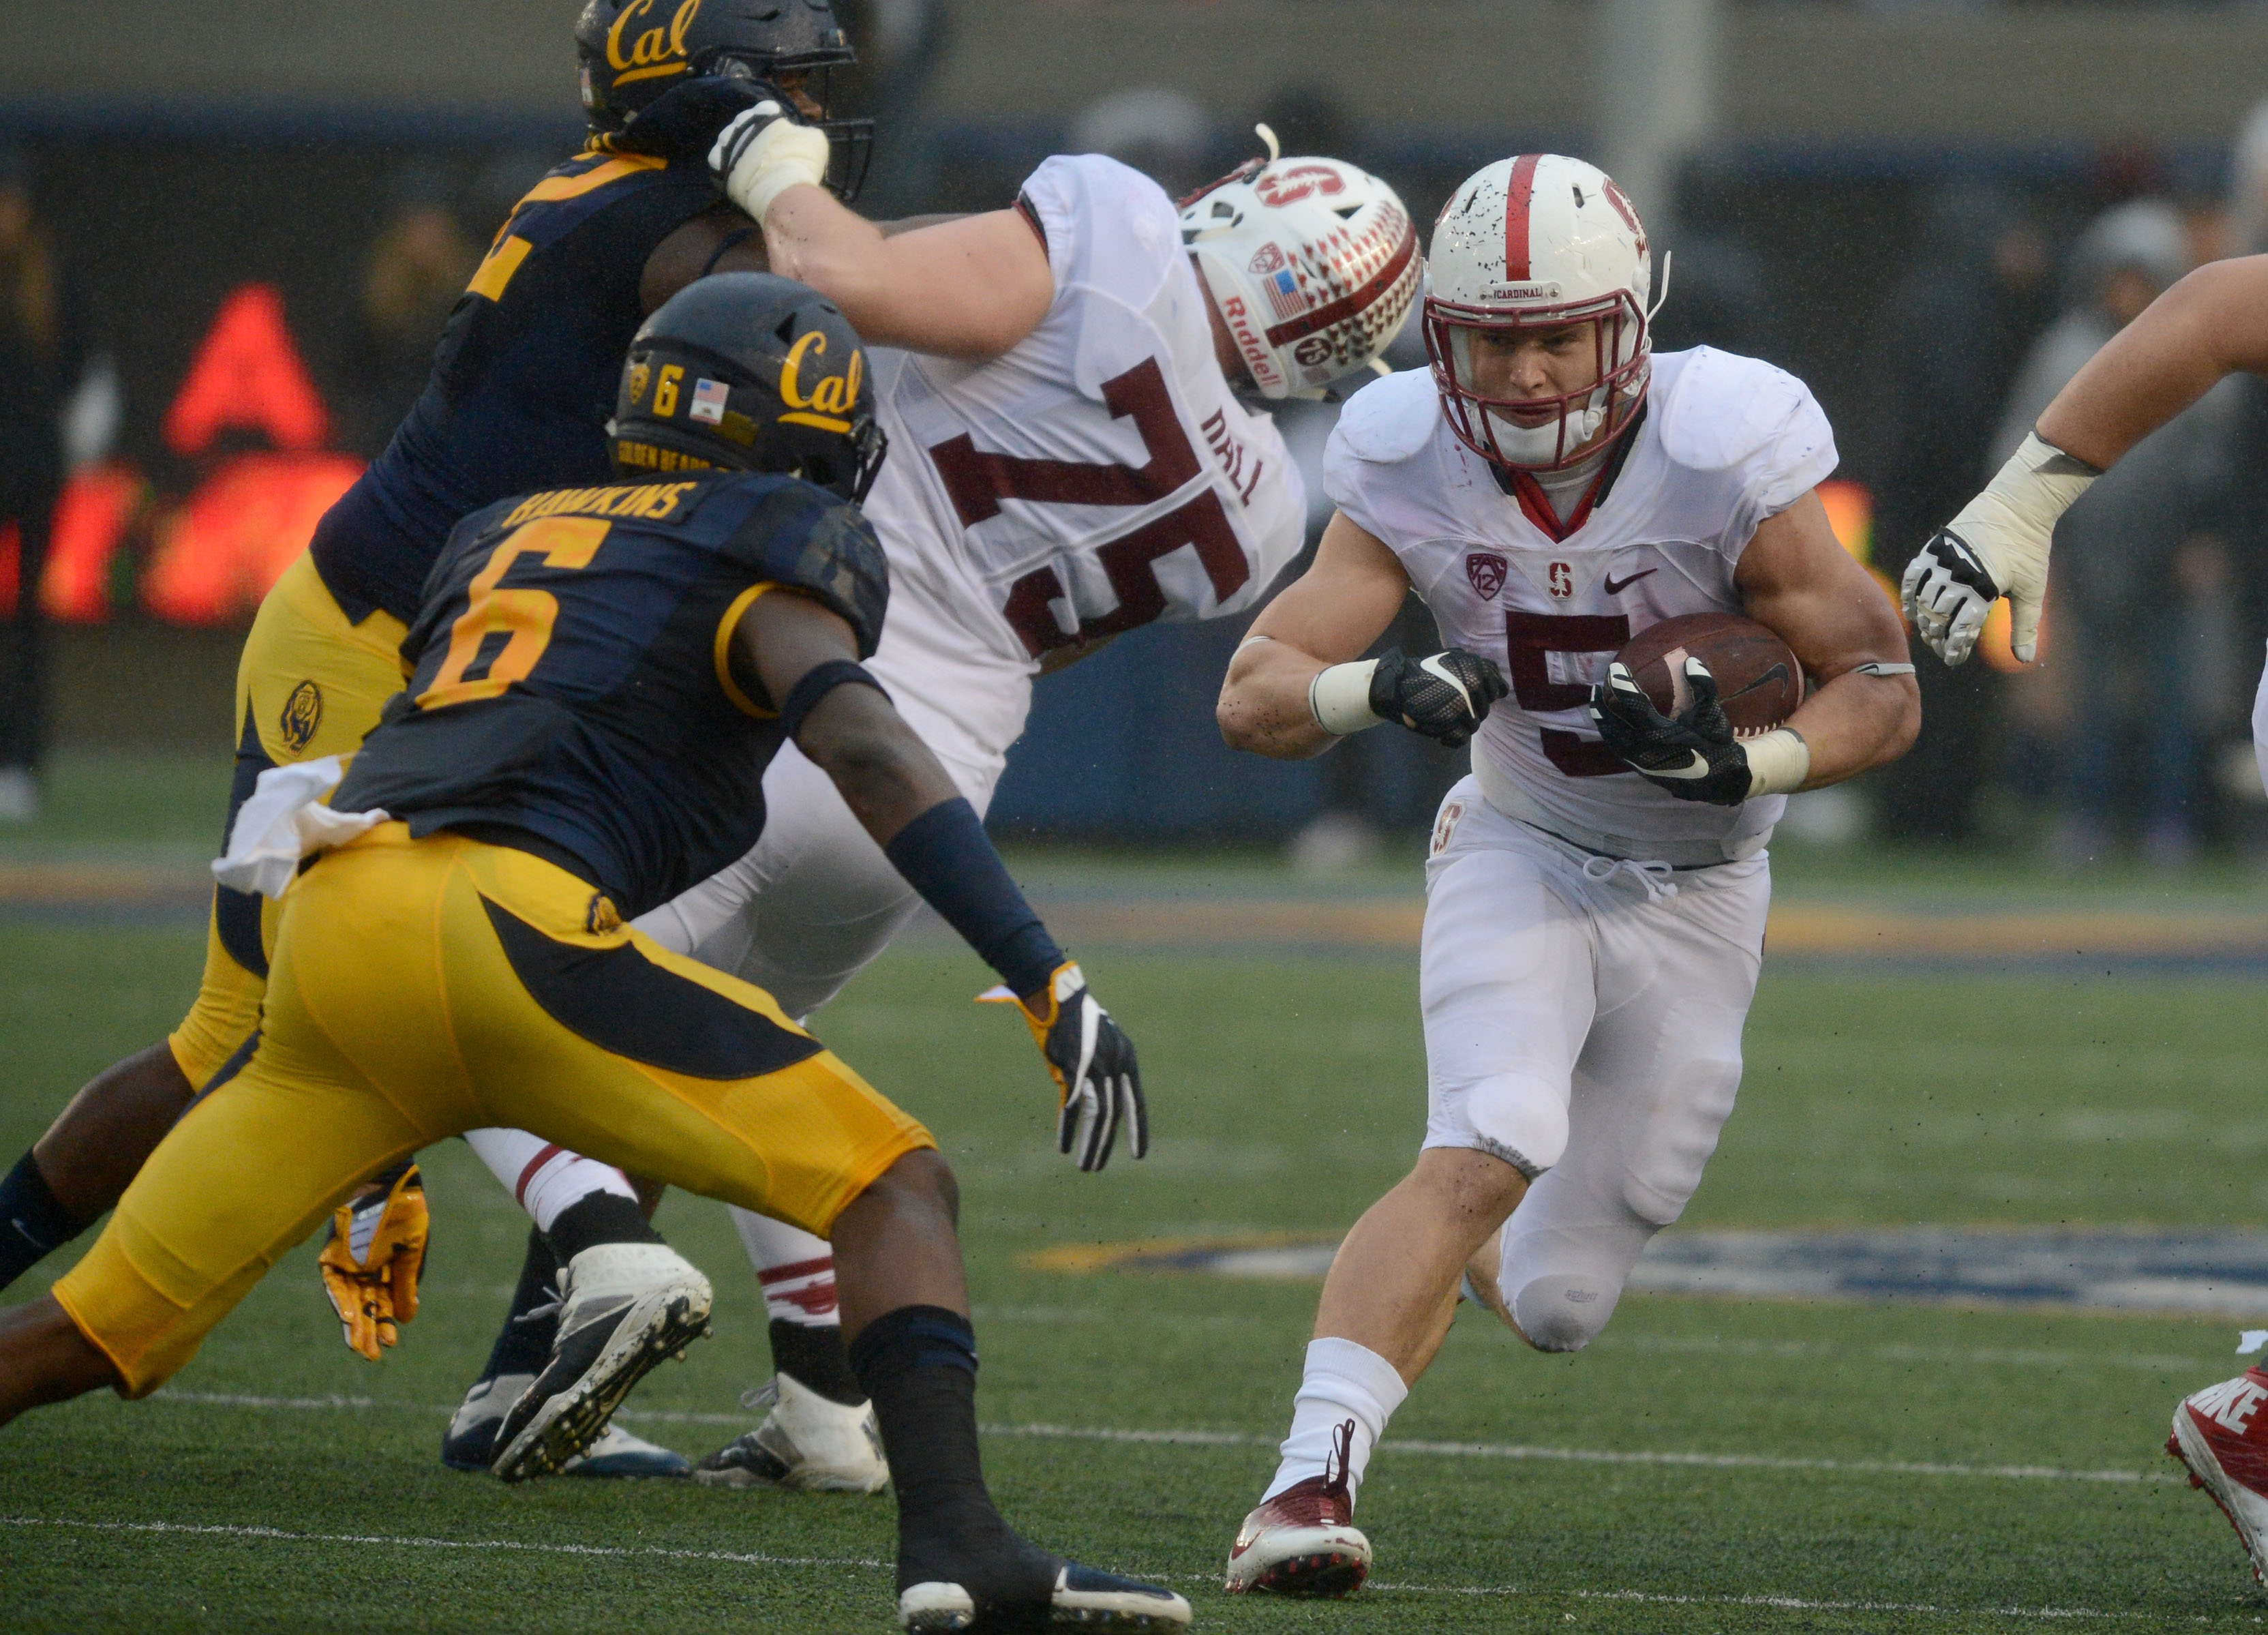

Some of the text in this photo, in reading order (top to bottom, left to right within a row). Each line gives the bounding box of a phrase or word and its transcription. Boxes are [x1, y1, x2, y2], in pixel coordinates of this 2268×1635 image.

[606, 0, 700, 70] Cal
[1496, 287, 1541, 299] CARDINAL
[779, 331, 862, 414] Cal
[1224, 295, 1282, 387] Riddell
[652, 363, 686, 419] 6
[501, 481, 697, 529] HAWKINS
[928, 355, 1250, 660] 75
[414, 516, 612, 711] 6
[1477, 574, 1496, 591] 12
[1505, 611, 1636, 777] 5
